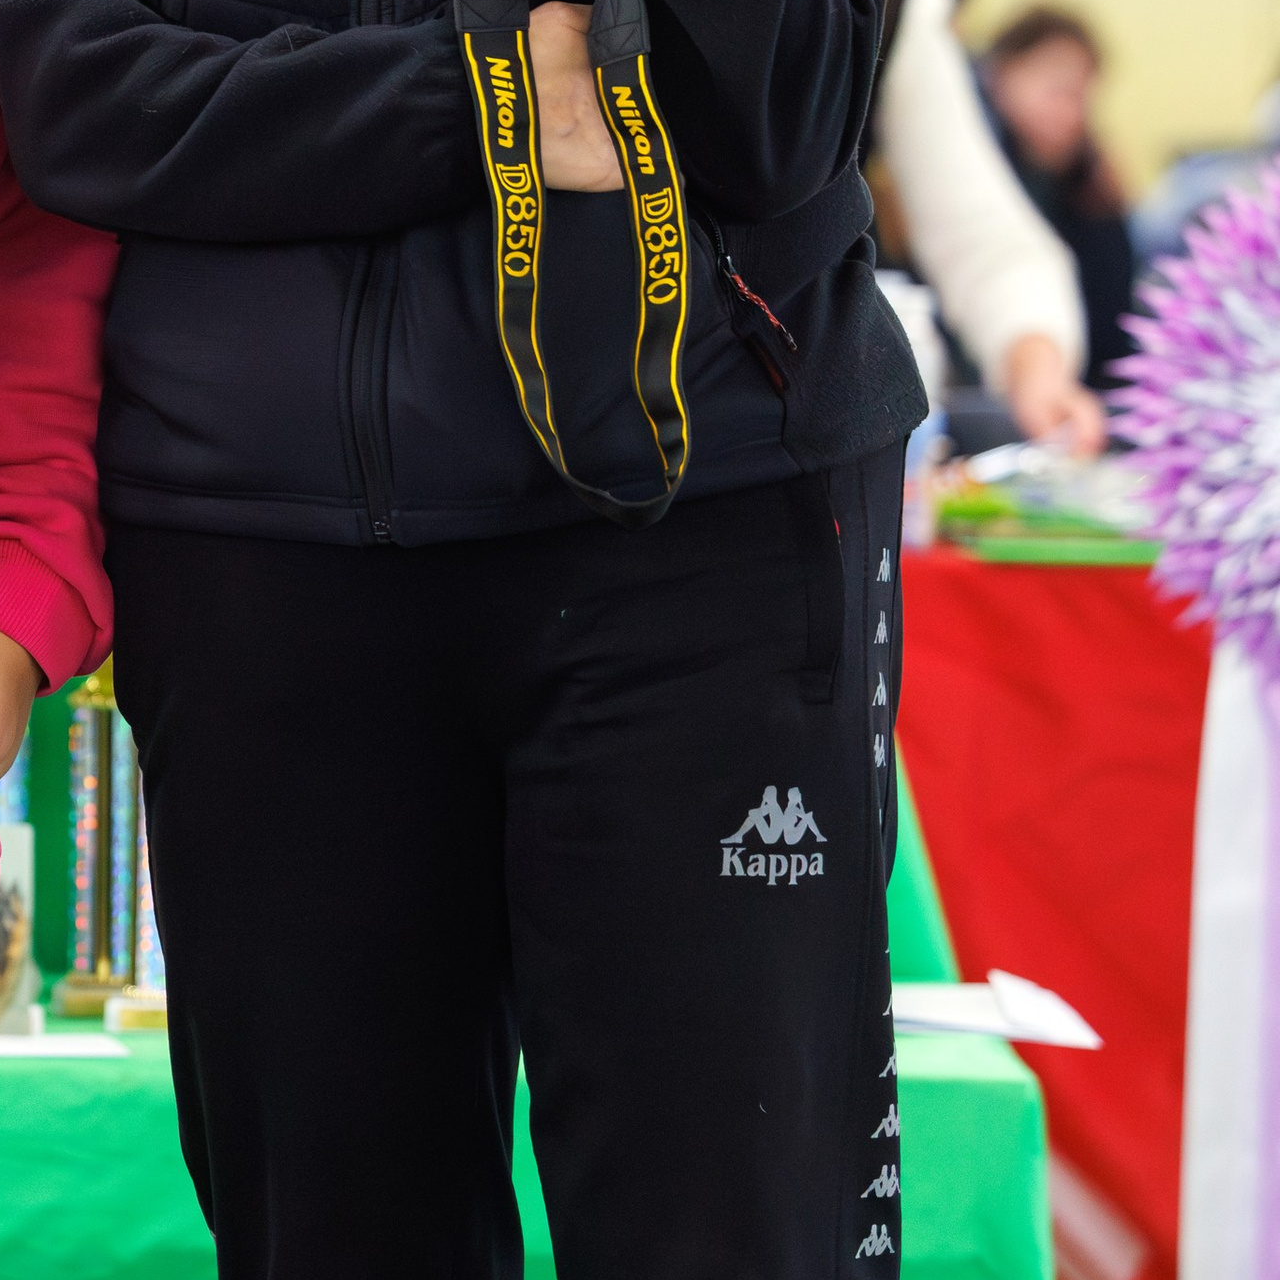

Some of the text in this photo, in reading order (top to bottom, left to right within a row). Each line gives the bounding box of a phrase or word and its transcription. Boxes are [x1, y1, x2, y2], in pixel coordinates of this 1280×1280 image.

[485, 56, 537, 278] Nikon D850
[611, 85, 680, 304] Nikon D850
[719, 846, 825, 886] Kappa
